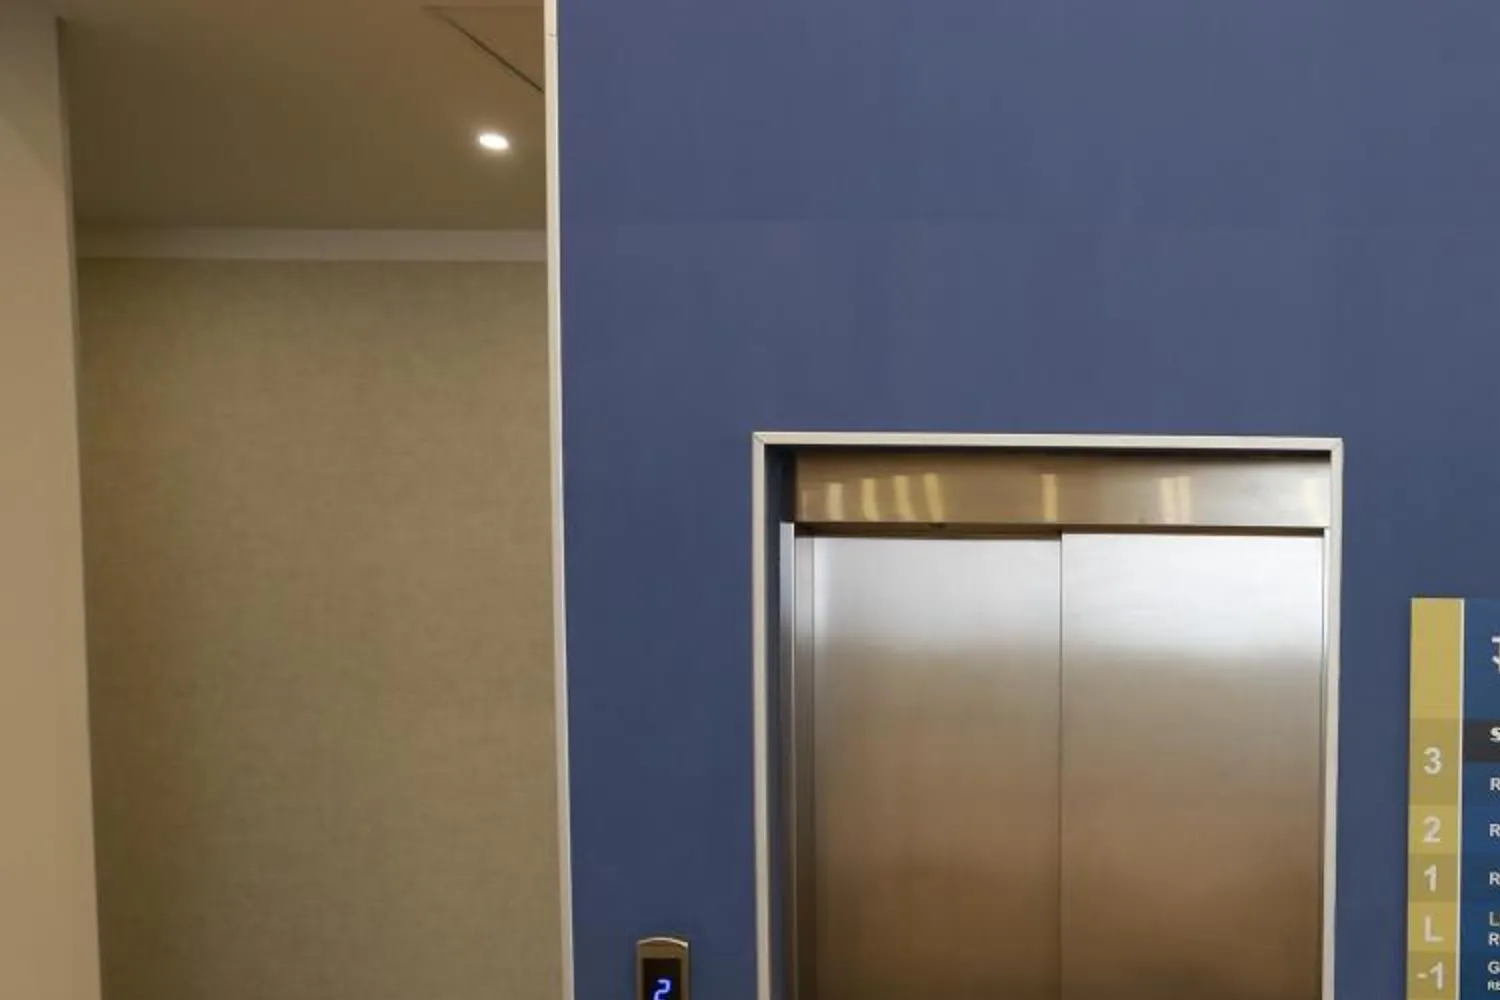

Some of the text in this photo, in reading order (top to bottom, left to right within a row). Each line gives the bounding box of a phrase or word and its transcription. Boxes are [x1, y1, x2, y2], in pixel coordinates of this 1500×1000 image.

[1423, 747, 1442, 775] 3
[1423, 815, 1441, 843] 2
[1423, 864, 1438, 892] 1
[1423, 915, 1444, 943] L
[1416, 961, 1444, 990] -1
